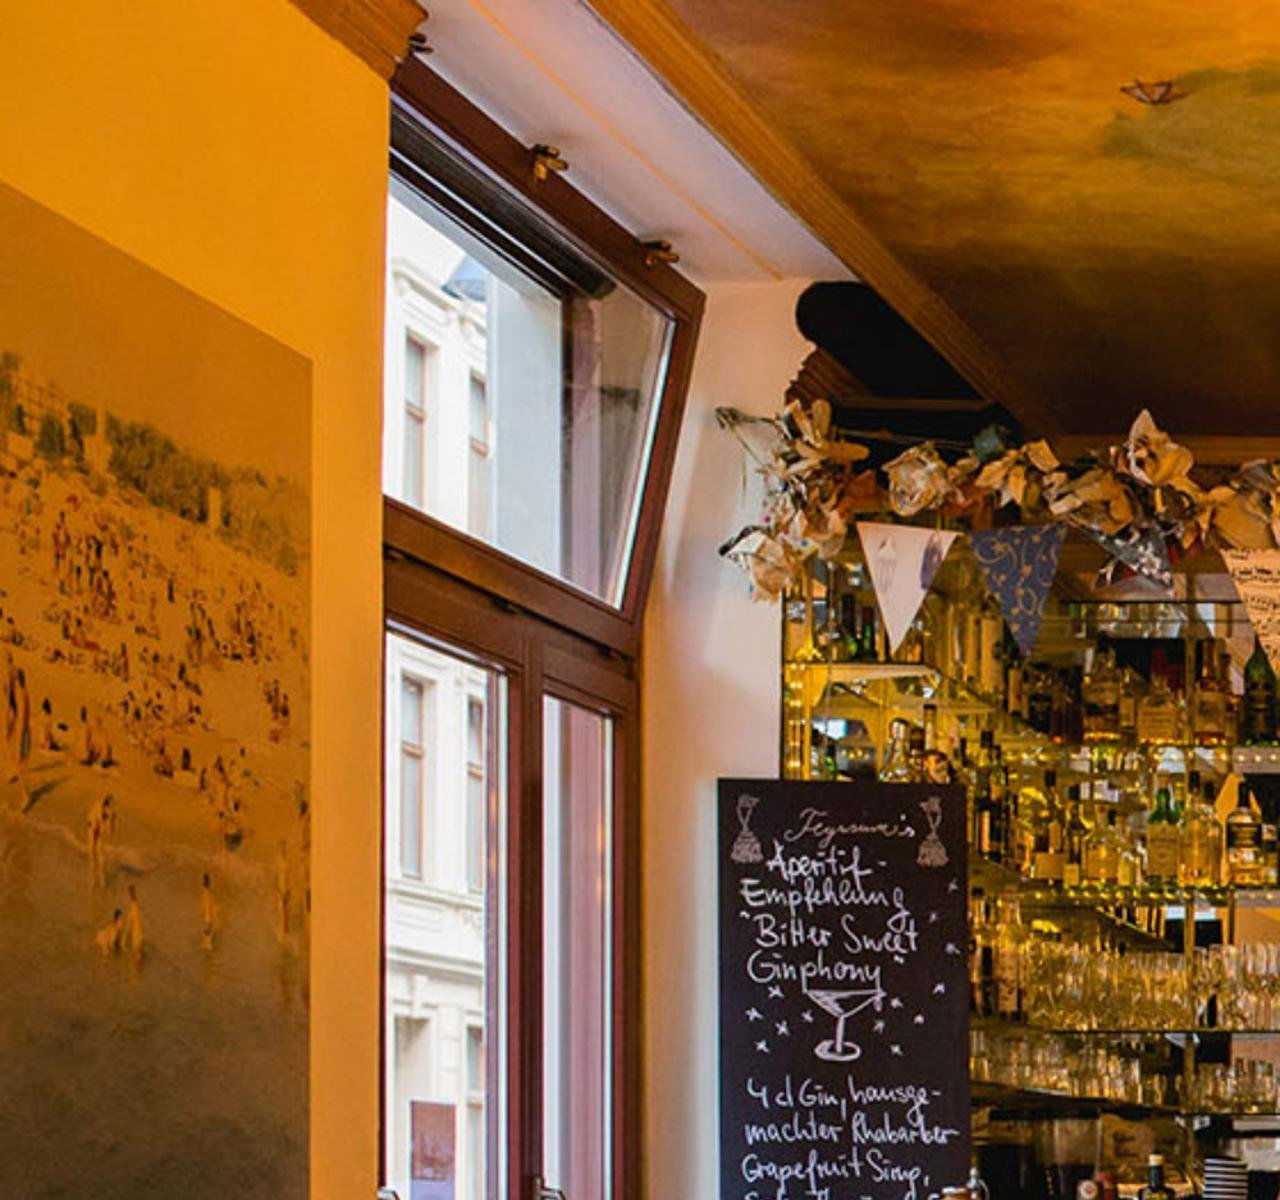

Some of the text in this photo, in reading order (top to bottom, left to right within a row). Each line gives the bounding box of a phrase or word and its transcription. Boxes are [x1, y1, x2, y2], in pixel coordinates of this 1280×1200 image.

[741, 878, 911, 932] Empfehlung
[841, 914, 919, 954] Sweet
[747, 1077, 769, 1109] 4
[744, 1111, 843, 1145] machter
[742, 1146, 863, 1195] Grapefruit
